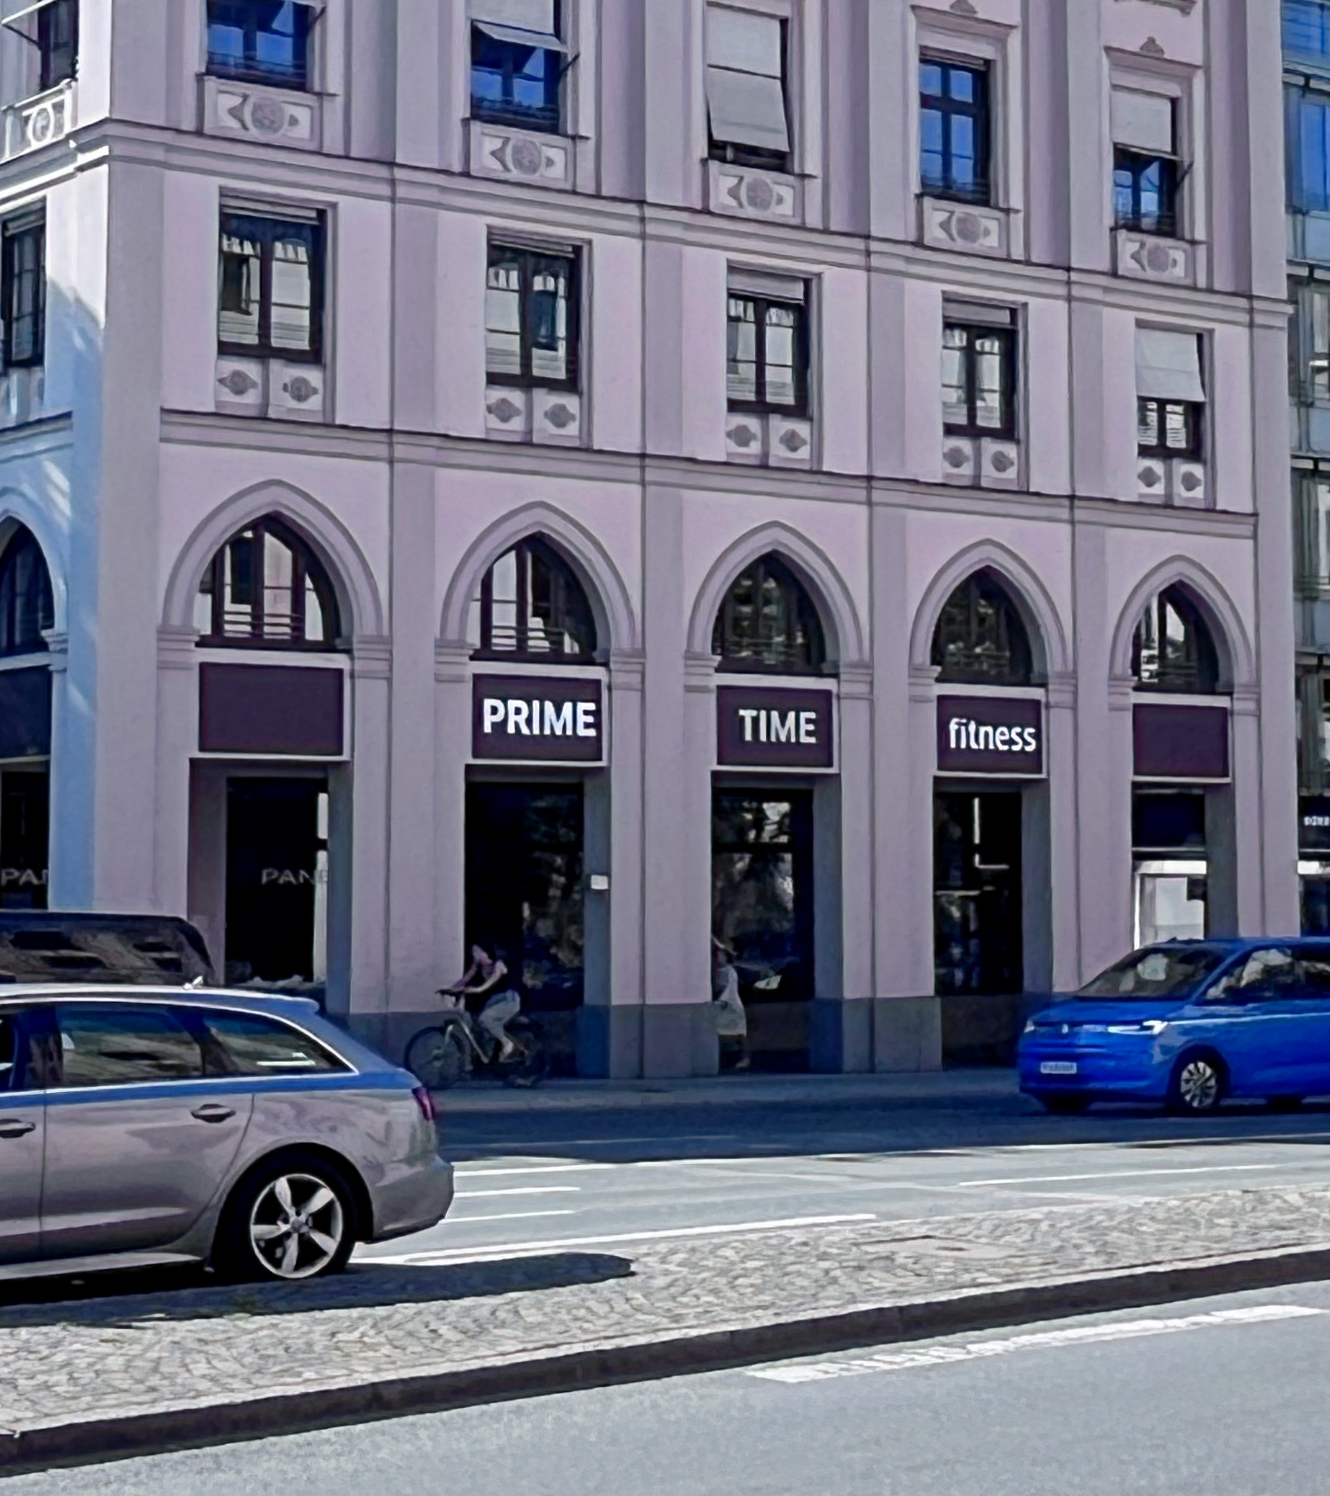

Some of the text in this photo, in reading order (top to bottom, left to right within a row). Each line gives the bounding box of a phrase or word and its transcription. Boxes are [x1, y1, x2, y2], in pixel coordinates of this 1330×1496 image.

[483, 698, 597, 736] PRIME
[738, 709, 818, 744] TIME
[949, 717, 1037, 752] fitness
